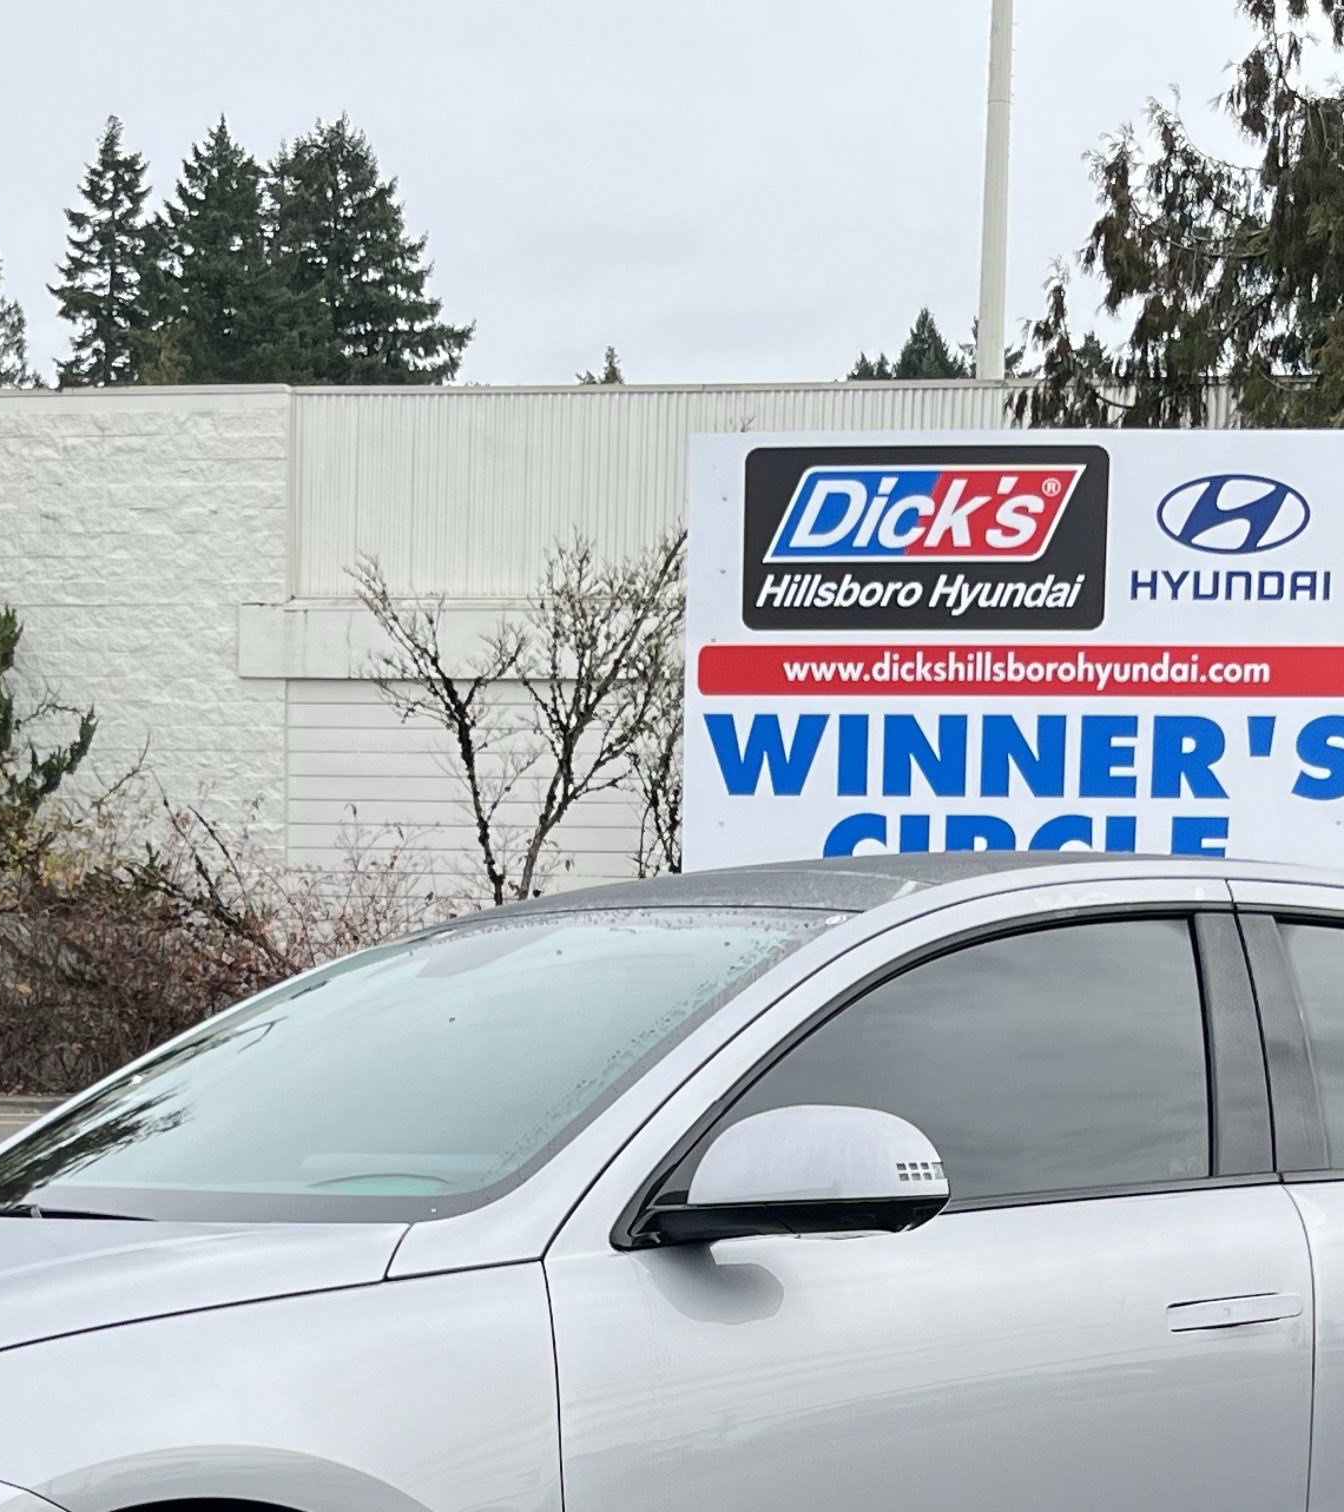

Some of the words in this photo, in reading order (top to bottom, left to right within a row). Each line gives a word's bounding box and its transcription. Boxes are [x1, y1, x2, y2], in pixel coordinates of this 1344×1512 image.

[789, 476, 1045, 549] Dick's
[756, 573, 924, 608] Hillsboro
[928, 573, 1086, 616] Hyundai
[1130, 570, 1331, 601] HYUNDAI
[783, 646, 1271, 691] www.dickshillsborohyundai.com
